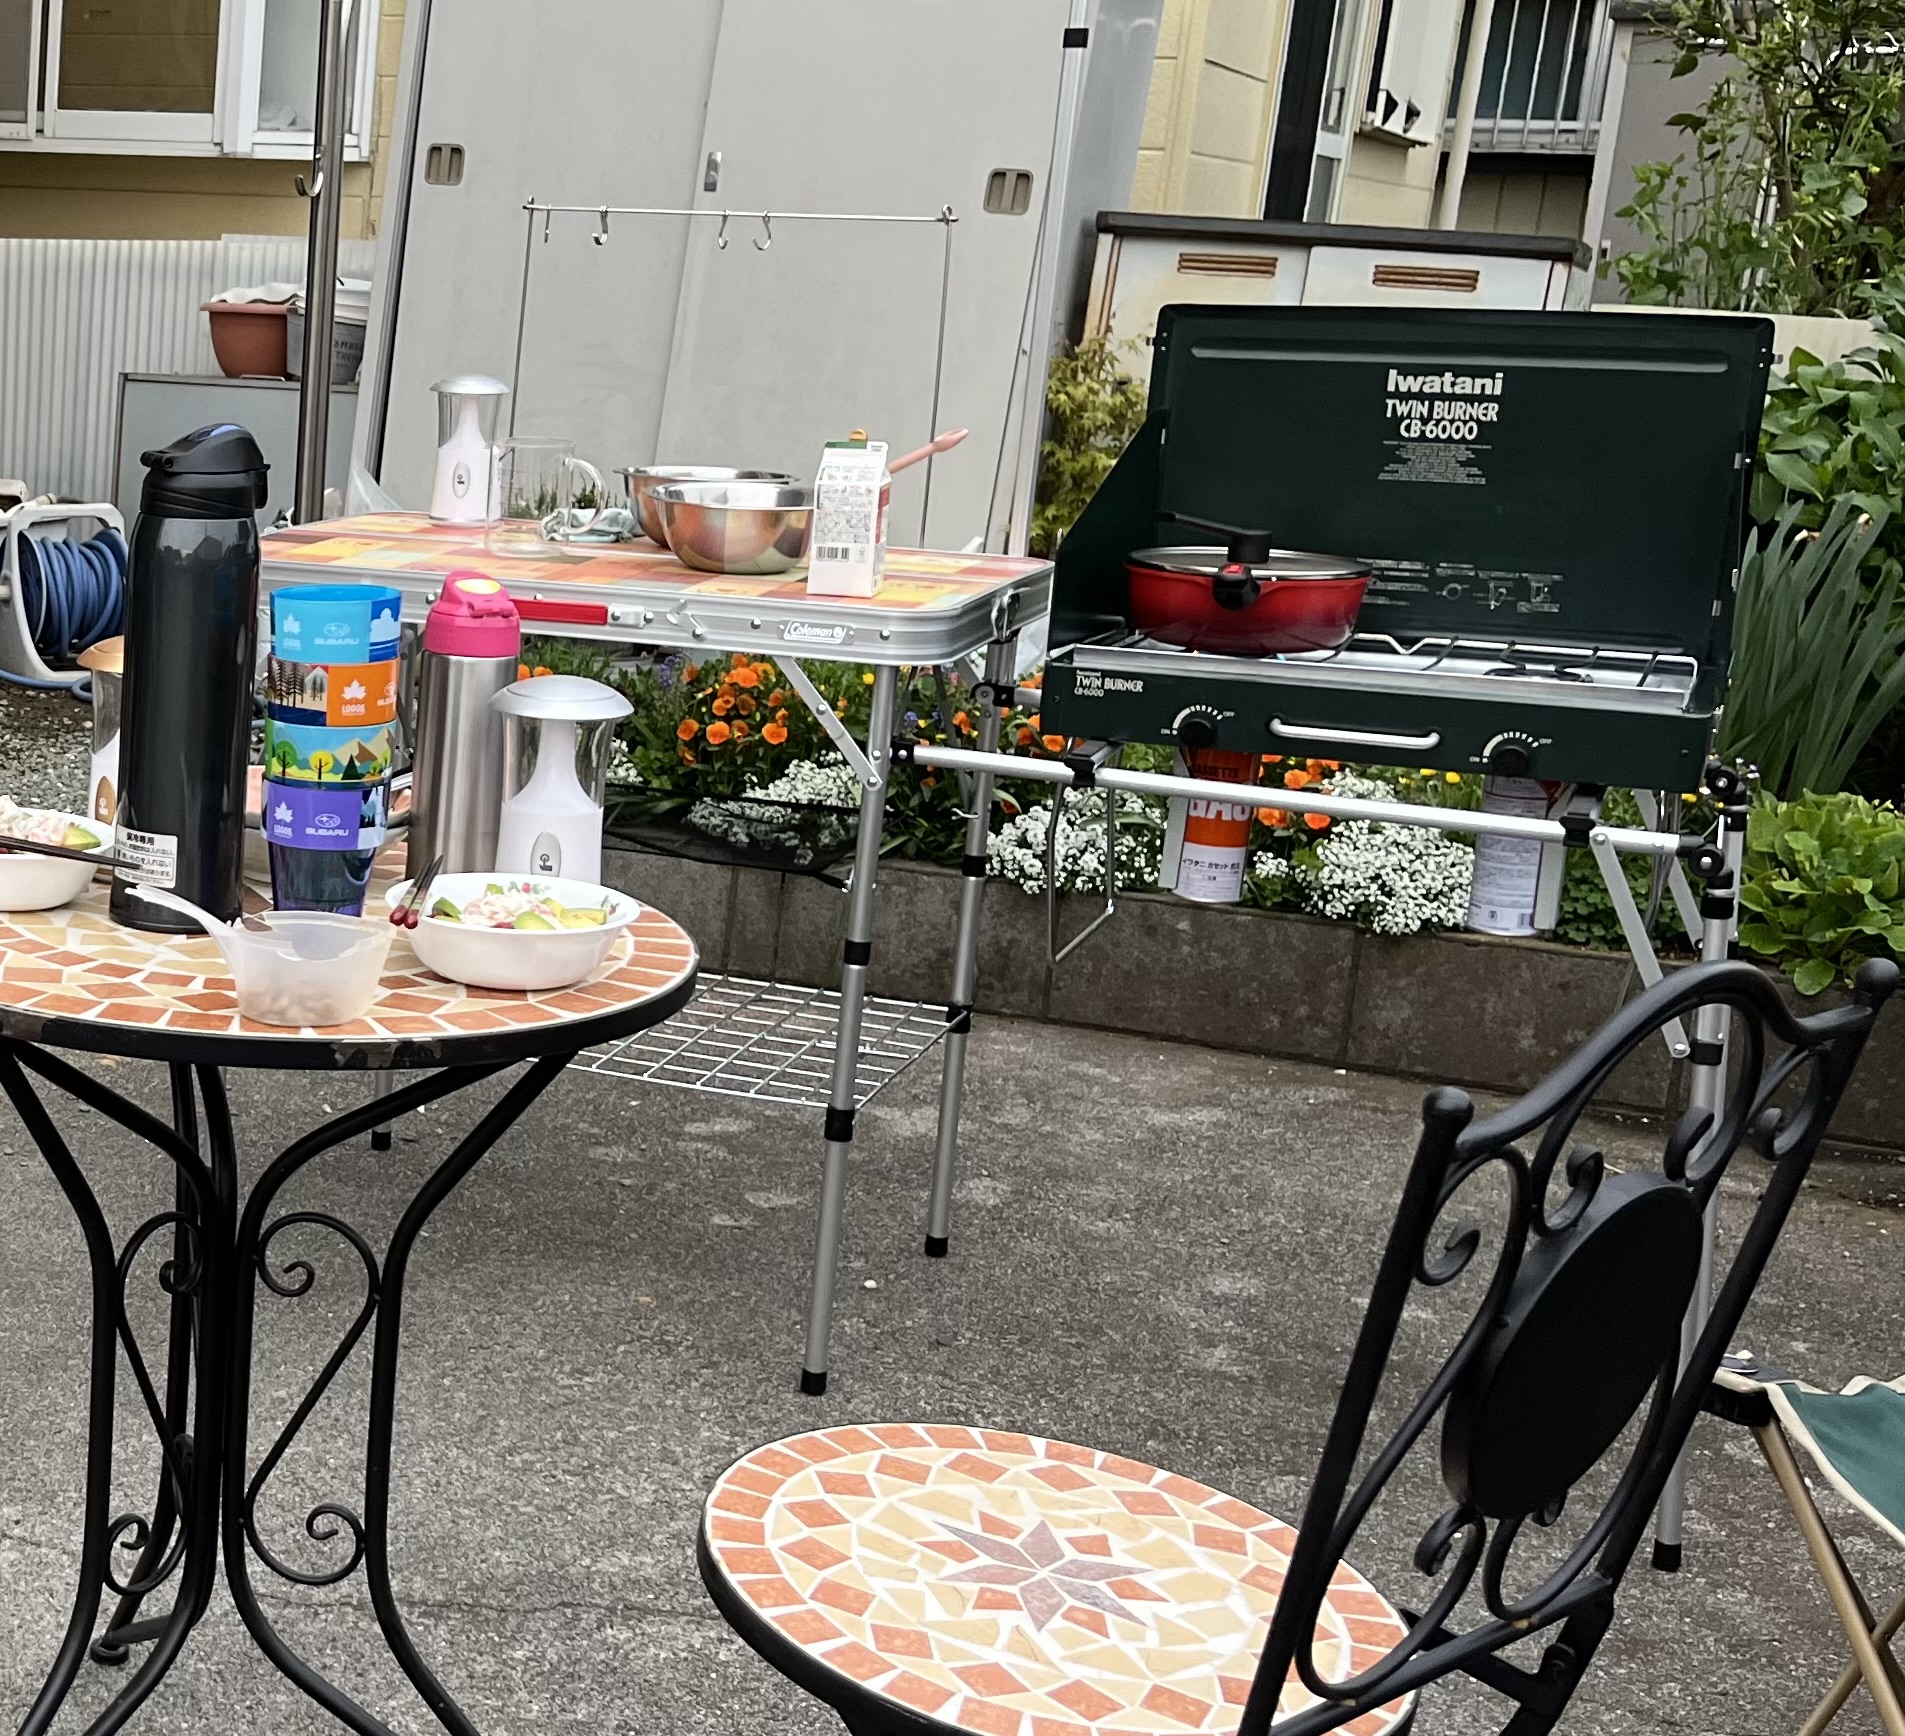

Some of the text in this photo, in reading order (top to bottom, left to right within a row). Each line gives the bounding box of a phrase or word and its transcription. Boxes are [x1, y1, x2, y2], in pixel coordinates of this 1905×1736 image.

[1387, 369, 1504, 396] Iwatani
[1385, 399, 1499, 422] TWIN BURNER
[1400, 418, 1478, 440] CB-6000
[790, 622, 833, 637] Coleman
[1076, 675, 1144, 692] TWIN BURNER
[305, 827, 349, 837] SUBARU
